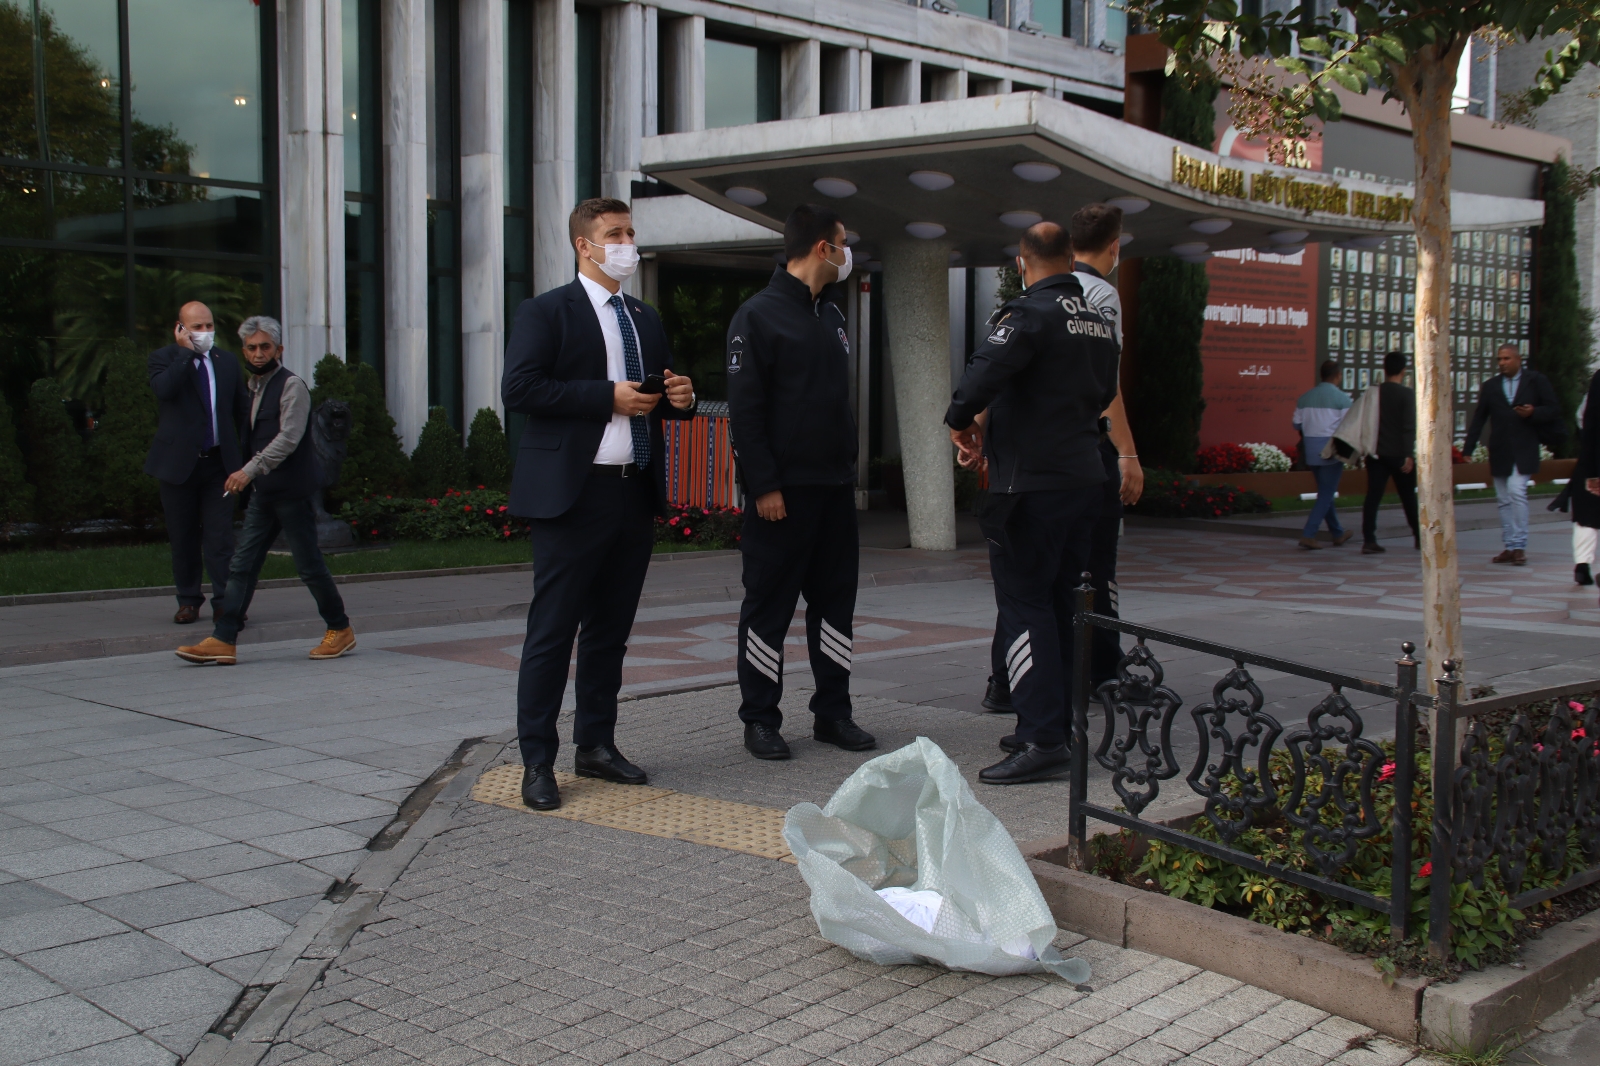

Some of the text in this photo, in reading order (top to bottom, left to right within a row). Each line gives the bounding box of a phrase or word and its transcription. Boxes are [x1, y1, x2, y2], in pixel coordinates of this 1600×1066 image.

[1172, 145, 1247, 200] İSTANBUL
[1055, 295, 1099, 315] ÖZE
[1203, 302, 1241, 326] overeignty
[1242, 303, 1267, 328] Belongs
[1268, 306, 1276, 325] to
[1276, 306, 1288, 326] the
[1288, 307, 1309, 329] People
[1066, 315, 1112, 340] GÜVENLİ
